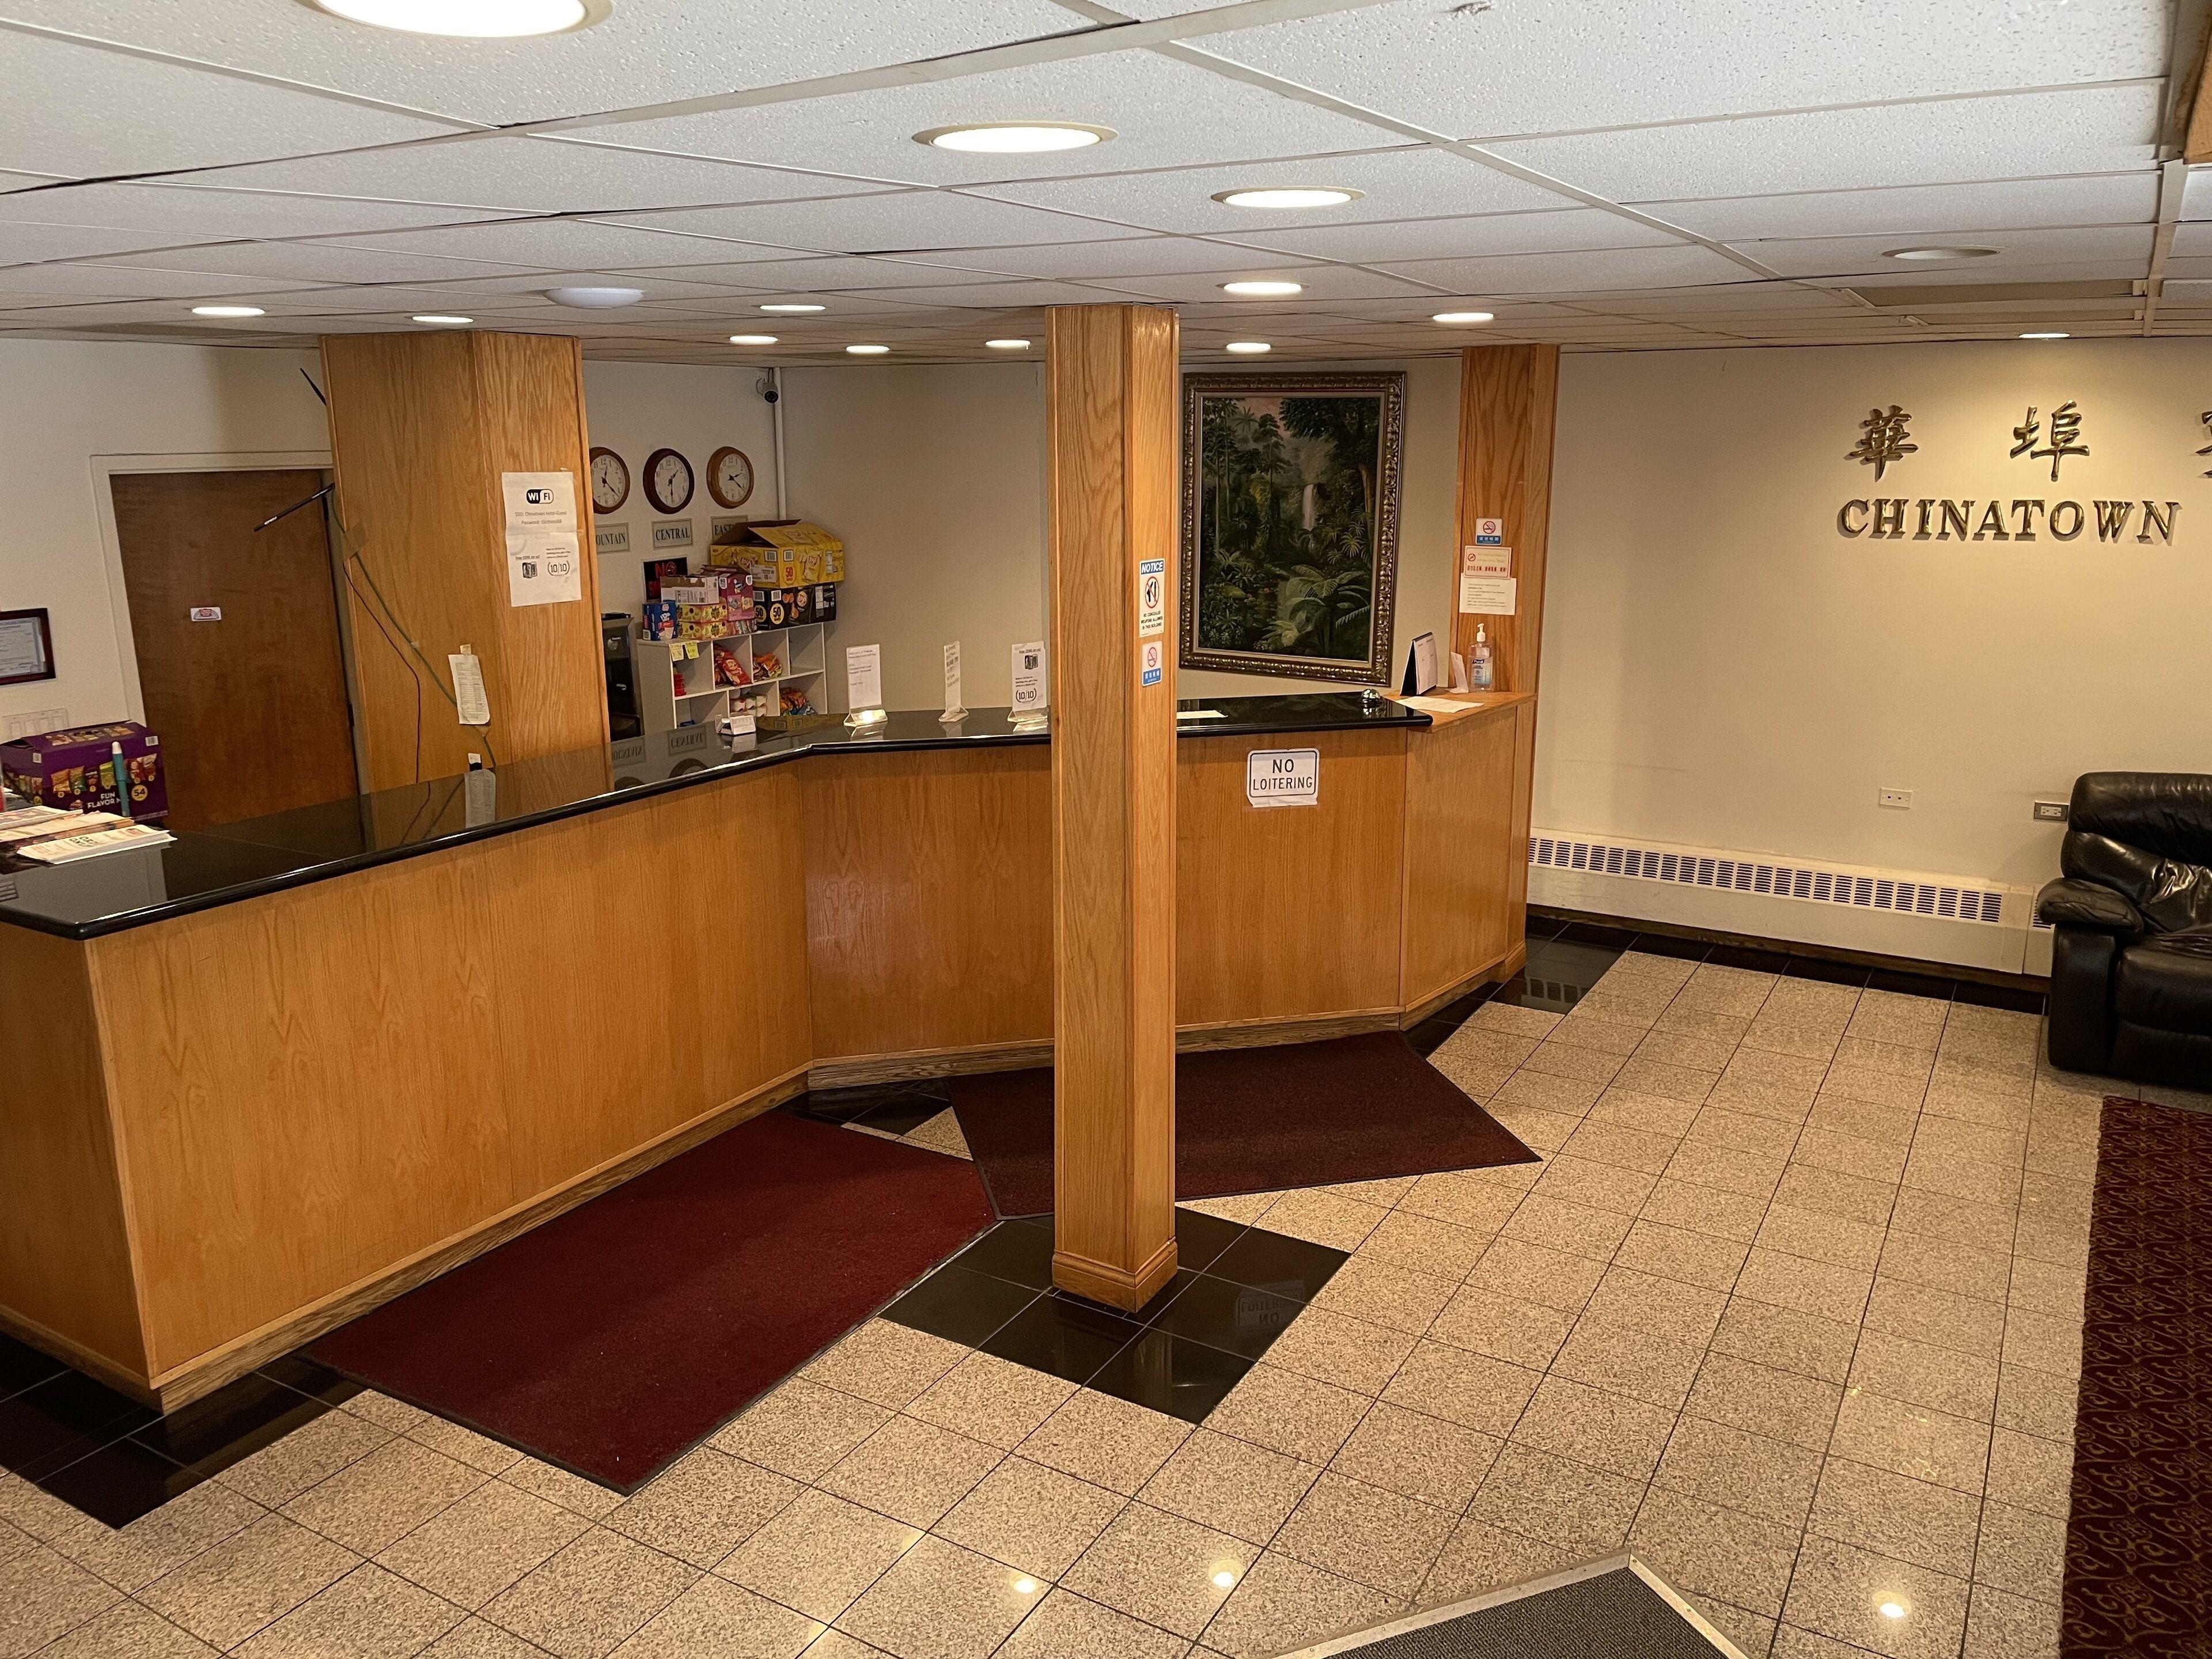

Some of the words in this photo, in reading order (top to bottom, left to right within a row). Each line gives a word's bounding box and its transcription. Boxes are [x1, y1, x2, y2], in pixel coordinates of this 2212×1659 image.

[1840, 498, 2180, 544] CHINATOWN
[656, 527, 691, 541] CENTRAL
[714, 524, 734, 536] EAST
[596, 532, 626, 546] OUNTAIN
[786, 567, 793, 577] 50
[1141, 562, 1163, 573] NOTICE
[755, 607, 764, 617] 50
[773, 606, 781, 618] 50
[1272, 759, 1294, 774] NO
[1253, 777, 1313, 790] LOITERING
[87, 798, 115, 809] FLAVOR
